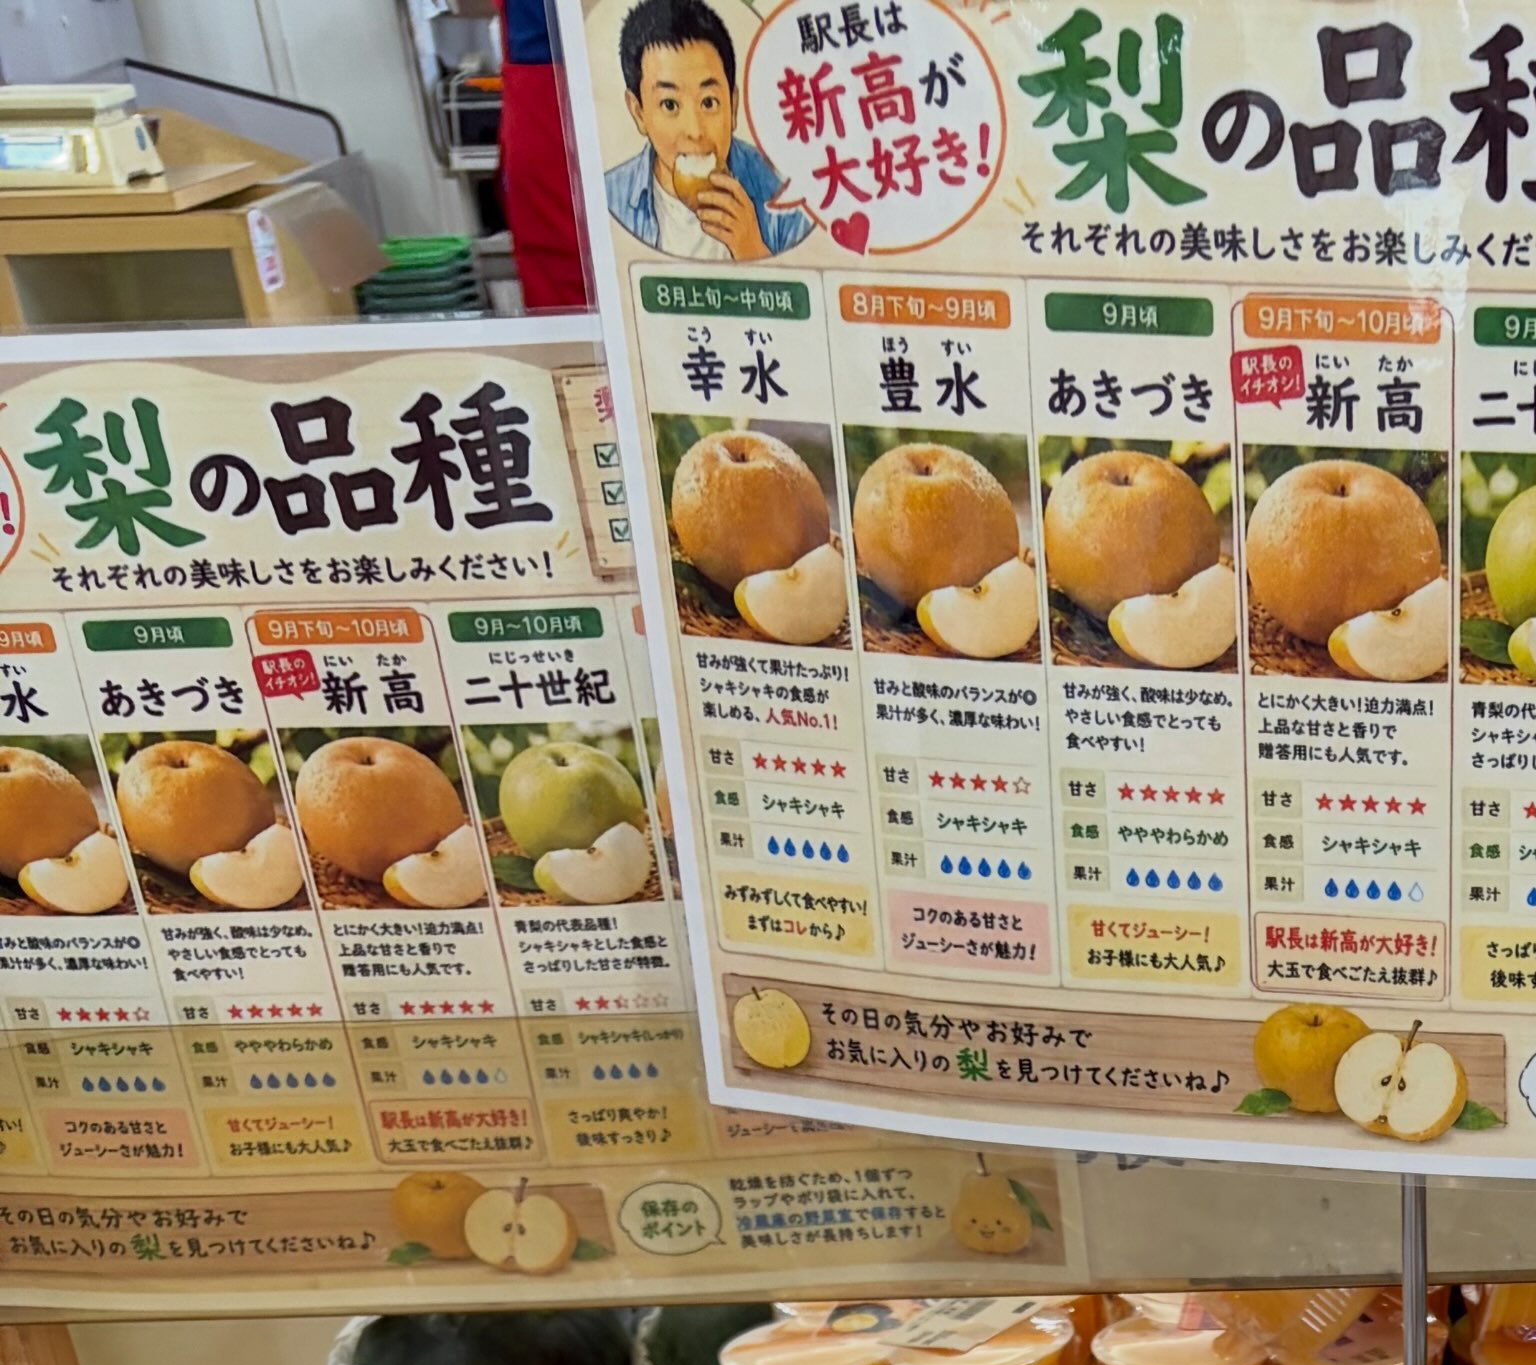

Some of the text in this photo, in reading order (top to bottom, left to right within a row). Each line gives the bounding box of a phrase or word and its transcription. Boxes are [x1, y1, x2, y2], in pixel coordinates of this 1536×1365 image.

[798, 2, 909, 54] 駅長は
[777, 51, 967, 143] 新高が
[813, 121, 992, 209] 大好き!
[1102, 304, 1158, 329] 9月頃
[686, 328, 773, 346] こう すい
[882, 338, 971, 357] ほう すい
[683, 346, 788, 403] 幸水
[1241, 355, 1294, 375] 駅長の
[1315, 354, 1413, 373] にい たか
[880, 357, 987, 416] 豊水
[1240, 375, 1301, 394] イチオシ!
[1048, 369, 1214, 423] あきづき
[1306, 377, 1425, 434] 新高
[24, 381, 553, 556] 梨の品種
[51, 553, 554, 591] それぞれの美味しさをお楽しみください!
[133, 624, 186, 644] 9月頃
[262, 657, 304, 673] 駅長の
[488, 650, 575, 665] にじっせいき
[696, 652, 849, 682] 甘みが強くて果汁たっぷり!
[98, 679, 245, 717] あきづき
[320, 670, 425, 715] 新高
[464, 667, 617, 708] 二十世紀
[700, 679, 829, 704] シャキシャキの食感が
[1063, 683, 1234, 708] 甘みが強く、酸味は少なめ。
[876, 704, 1041, 731] 果汁が多く、濃厚な味わい!
[1065, 710, 1221, 732] やさしい食感でとっても
[1258, 718, 1397, 740] 上品な甘さと香りで
[1066, 734, 1145, 753] 食べやすい!
[1258, 743, 1409, 765] 贈答用にも人気です。
[709, 749, 735, 765] 甘さ
[714, 791, 740, 806] 食感
[1068, 781, 1097, 797] 甘さ
[762, 794, 845, 819] シャキシャキ
[1470, 801, 1501, 817] 甘さ
[936, 812, 1028, 836] シャキシャキ
[1070, 823, 1100, 839] 食感
[719, 832, 745, 848] 果汁
[1117, 827, 1229, 847] やややわらかめ
[1321, 836, 1422, 858] シャキシャキ
[1469, 843, 1500, 859] 食感
[1073, 866, 1102, 881] 果汁
[724, 885, 868, 916] みずみずしくて食べやすい!
[1469, 887, 1501, 902] 果汁
[912, 907, 1023, 931] コクのある甘さと
[1090, 921, 1210, 943] 甘くてジューシー!
[1264, 926, 1438, 957] 駅長は新高が大好き!
[168, 944, 306, 961] やさしい食感でとっても
[339, 941, 456, 958] 上品な甘さと香りで
[901, 932, 1036, 961] ジューシーさが魅力!
[173, 966, 245, 981] 食べやすい!
[822, 1003, 1092, 1048] その日の気分やお好みで
[640, 1199, 698, 1218] 保存の
[640, 1218, 706, 1241] ポイント
